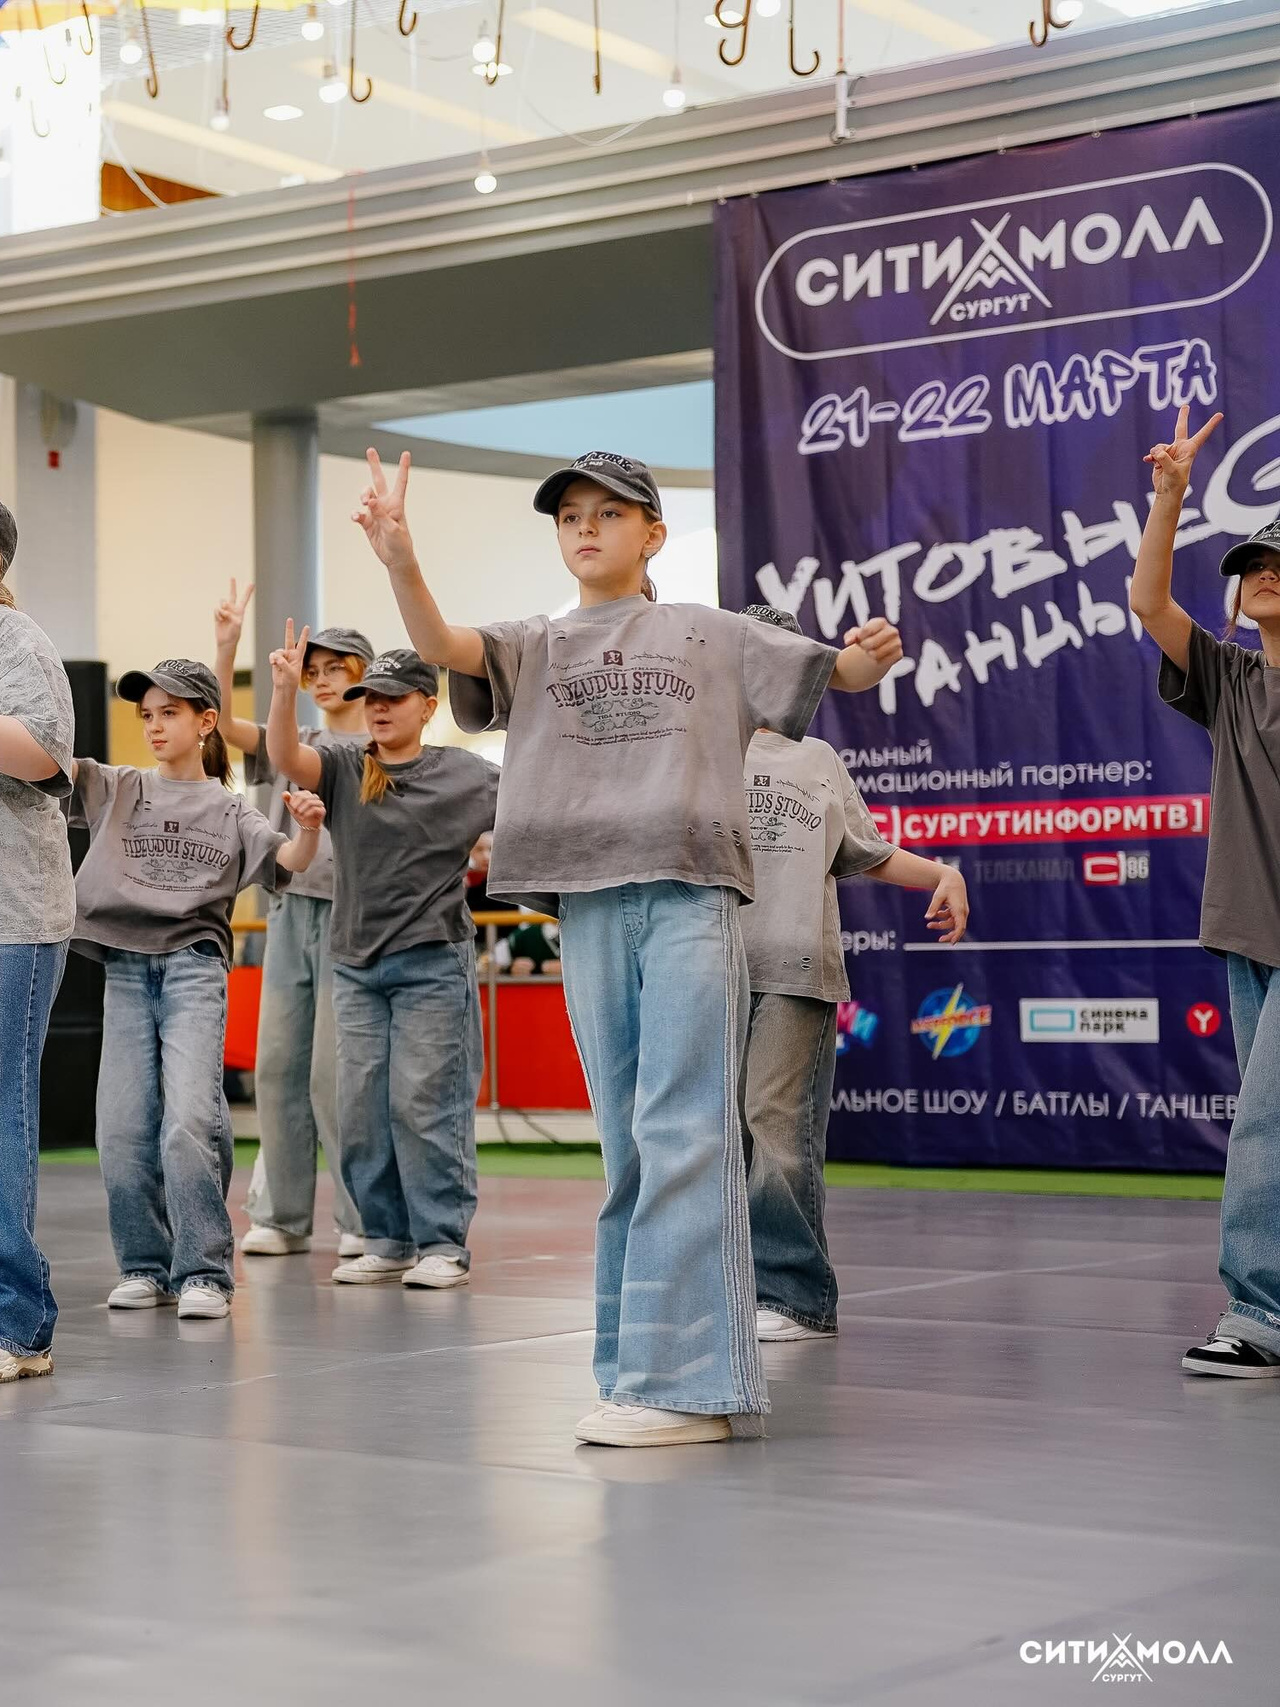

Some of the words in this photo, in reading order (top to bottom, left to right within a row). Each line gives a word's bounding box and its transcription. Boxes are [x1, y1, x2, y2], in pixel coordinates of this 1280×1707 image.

[949, 292, 1032, 322] СУРГУТ
[797, 374, 993, 456] 21-22
[1004, 338, 1219, 429] МАРТА
[1021, 759, 1153, 791] партнер:
[775, 795, 823, 830] STUDIO
[1079, 1020, 1126, 1036] парк
[830, 1088, 919, 1113] ЛЬНОЕ
[923, 1088, 989, 1116] ШОУ
